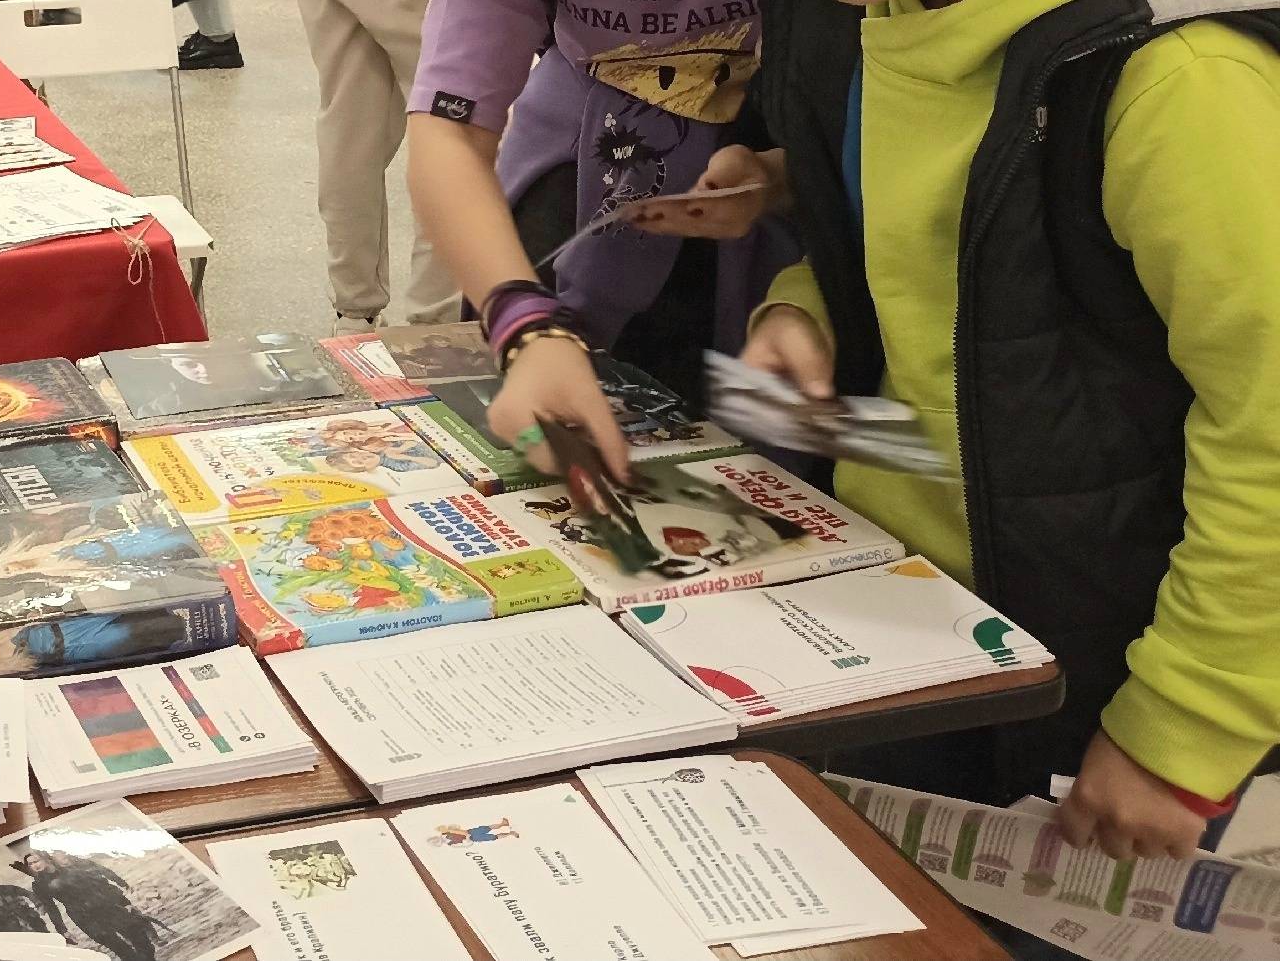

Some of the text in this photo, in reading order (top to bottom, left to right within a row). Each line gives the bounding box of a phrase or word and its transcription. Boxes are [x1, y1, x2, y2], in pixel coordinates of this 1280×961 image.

[640, 12, 679, 34] BE
[612, 144, 635, 160] WOW
[1, 464, 63, 511] ГЭТСБИ
[747, 468, 791, 490] КОТ
[784, 492, 808, 502] И
[404, 501, 480, 558] ЗОЛОТОЙ
[446, 494, 504, 543] ПРИКЛЮЧЕНИЯ
[460, 493, 531, 548] БУРАТИНО
[780, 509, 848, 544] ДЯДЯ
[401, 614, 443, 628] ЗОЛОТОЙ
[504, 897, 527, 923] папу
[521, 923, 550, 955] звали
